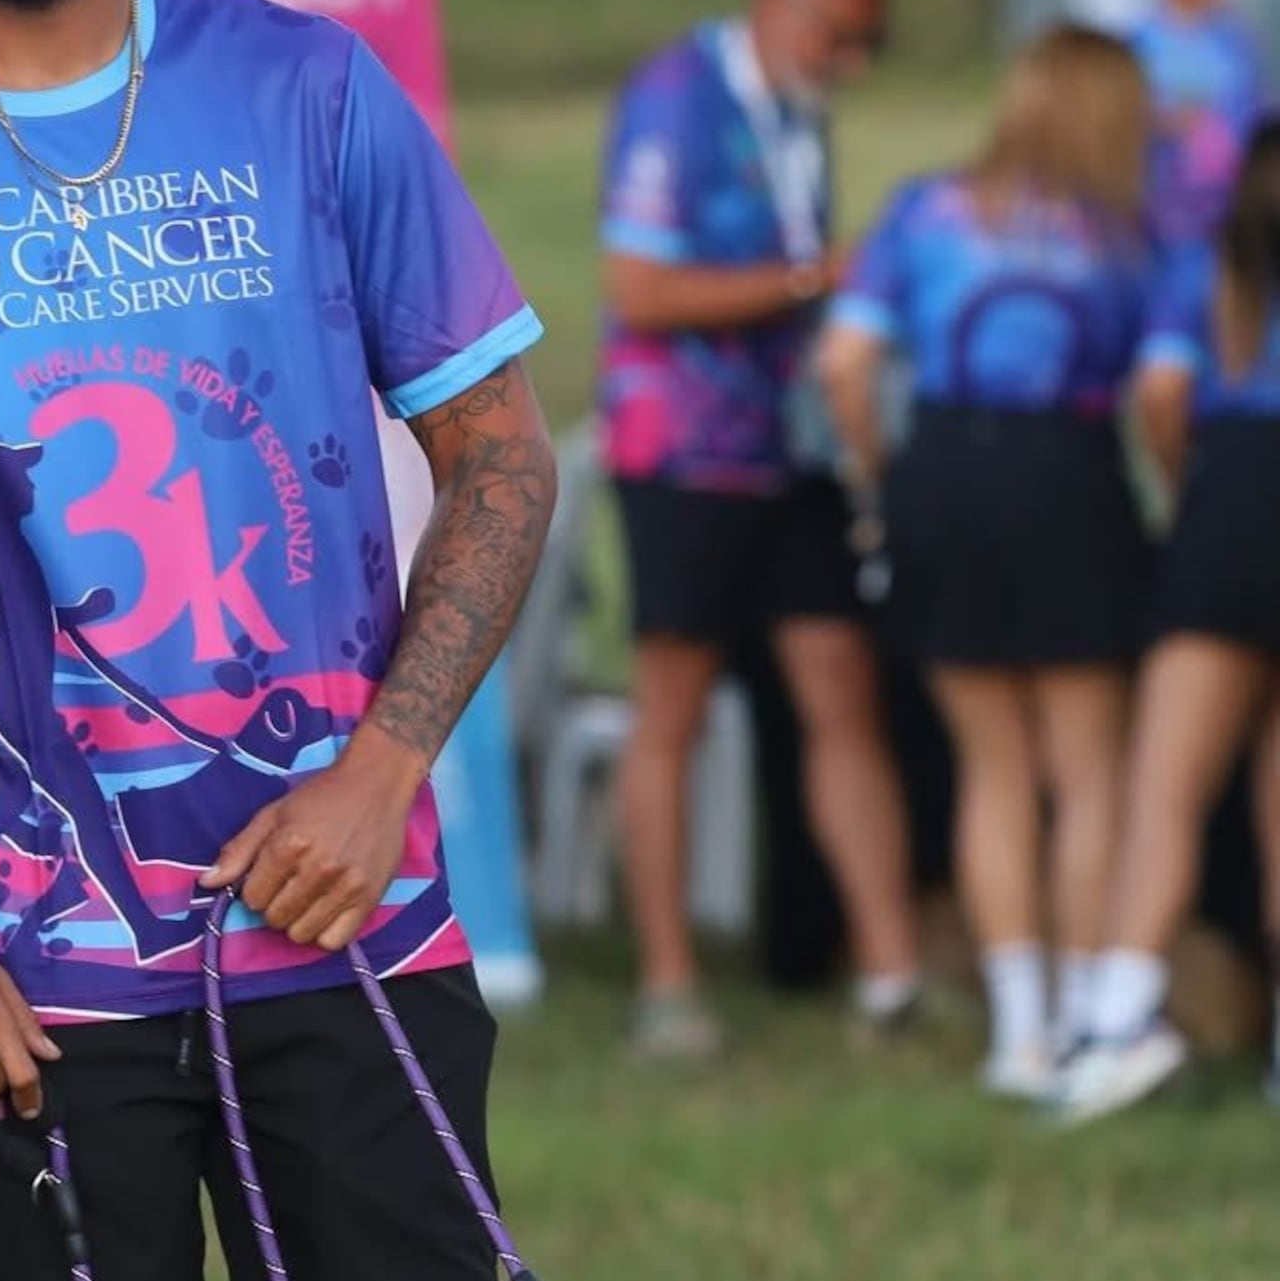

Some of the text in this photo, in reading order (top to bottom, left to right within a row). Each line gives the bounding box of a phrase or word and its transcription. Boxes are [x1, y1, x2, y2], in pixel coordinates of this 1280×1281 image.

[11, 214, 273, 286] CANCER
[108, 266, 275, 318] SERVICES
[13, 344, 315, 587] HUELLAS DE VIDA Y ESPERANZA
